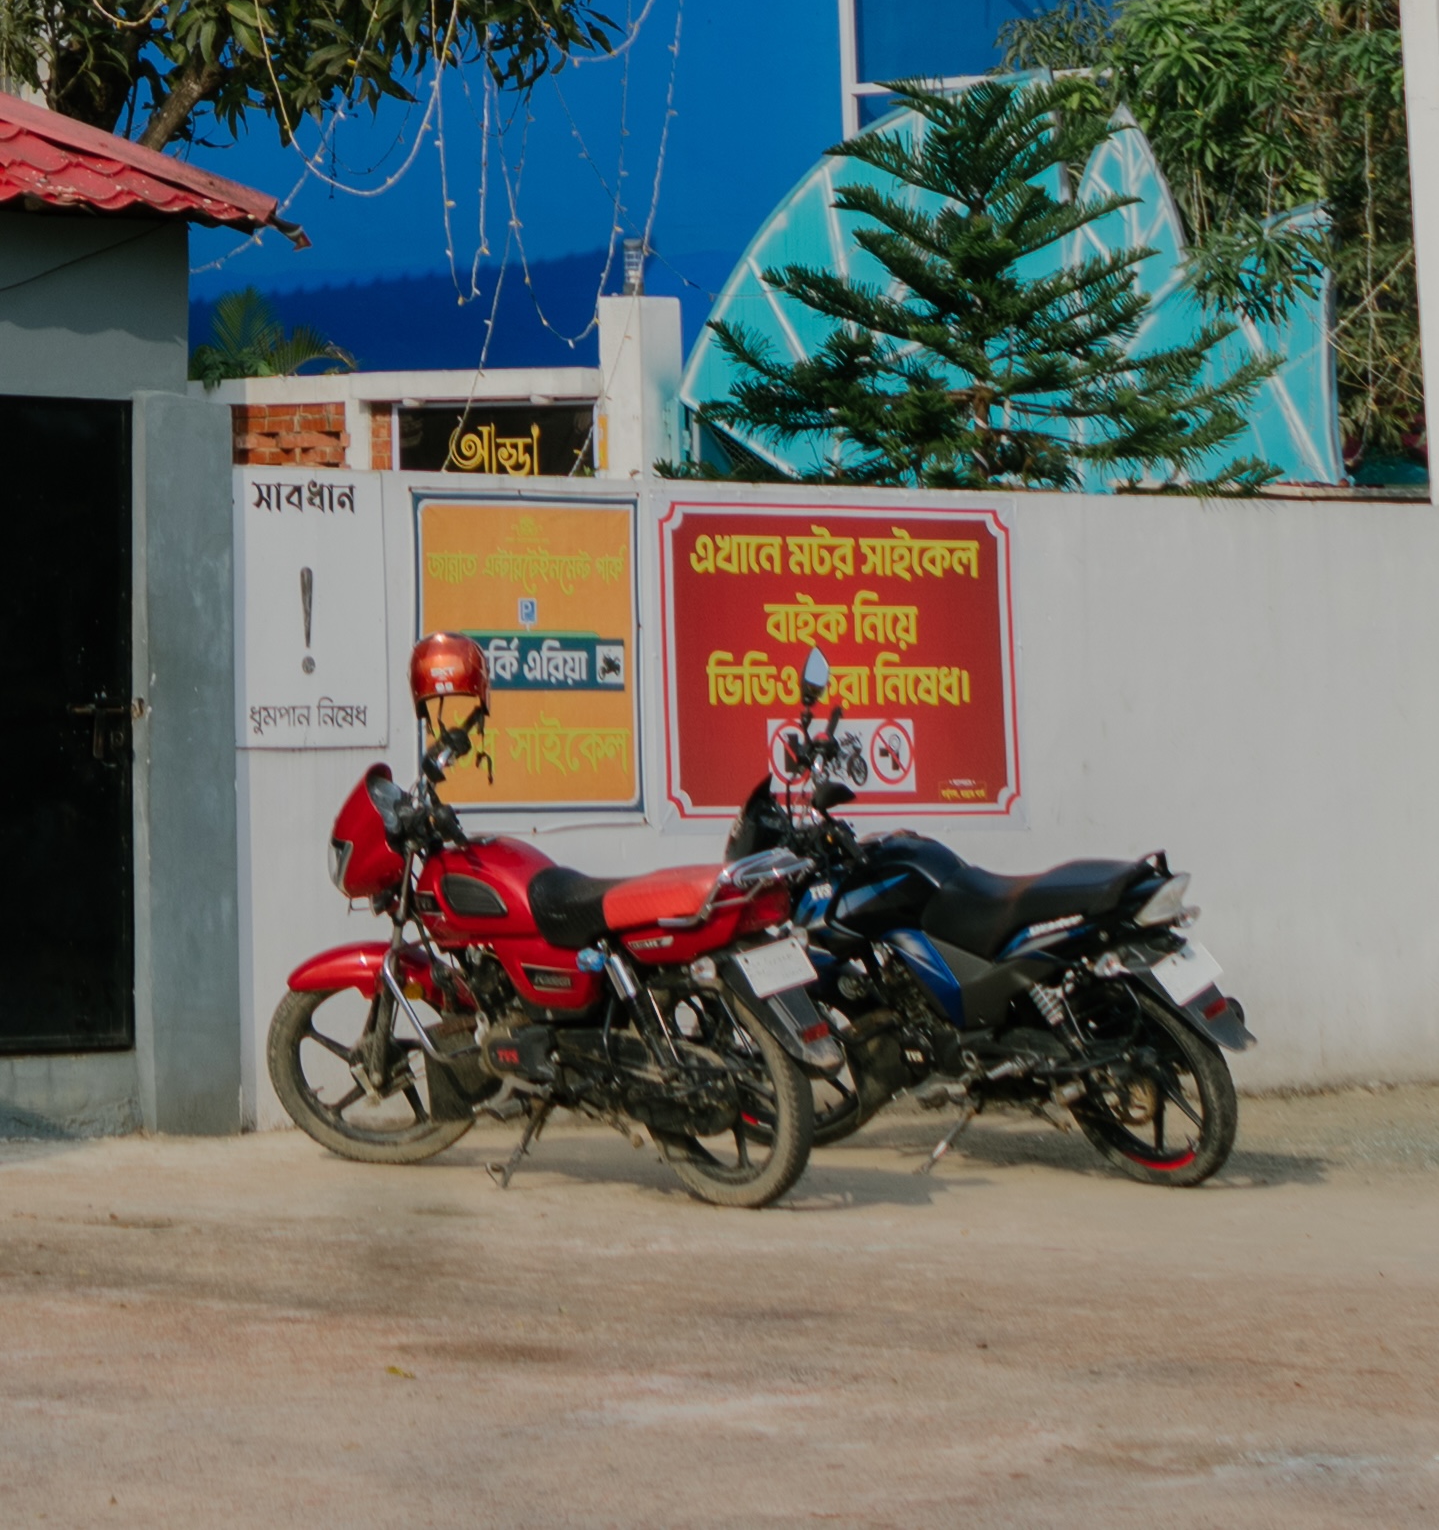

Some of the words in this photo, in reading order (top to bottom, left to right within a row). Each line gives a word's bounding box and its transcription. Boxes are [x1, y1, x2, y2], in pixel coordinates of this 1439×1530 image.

[251, 479, 357, 514] সাবধান
[427, 550, 479, 585] জান্নাত
[595, 544, 627, 584] পার্ক
[689, 533, 783, 575] এখানে
[786, 524, 856, 581] মটর
[858, 526, 980, 582] সাইকেল
[763, 592, 849, 648] বাইক
[852, 590, 919, 651] নিয়ে
[523, 638, 589, 686] এরিয়া
[707, 650, 800, 706] ভিডিও
[316, 696, 368, 728] নিষেধ
[504, 710, 631, 777] সাইকেল
